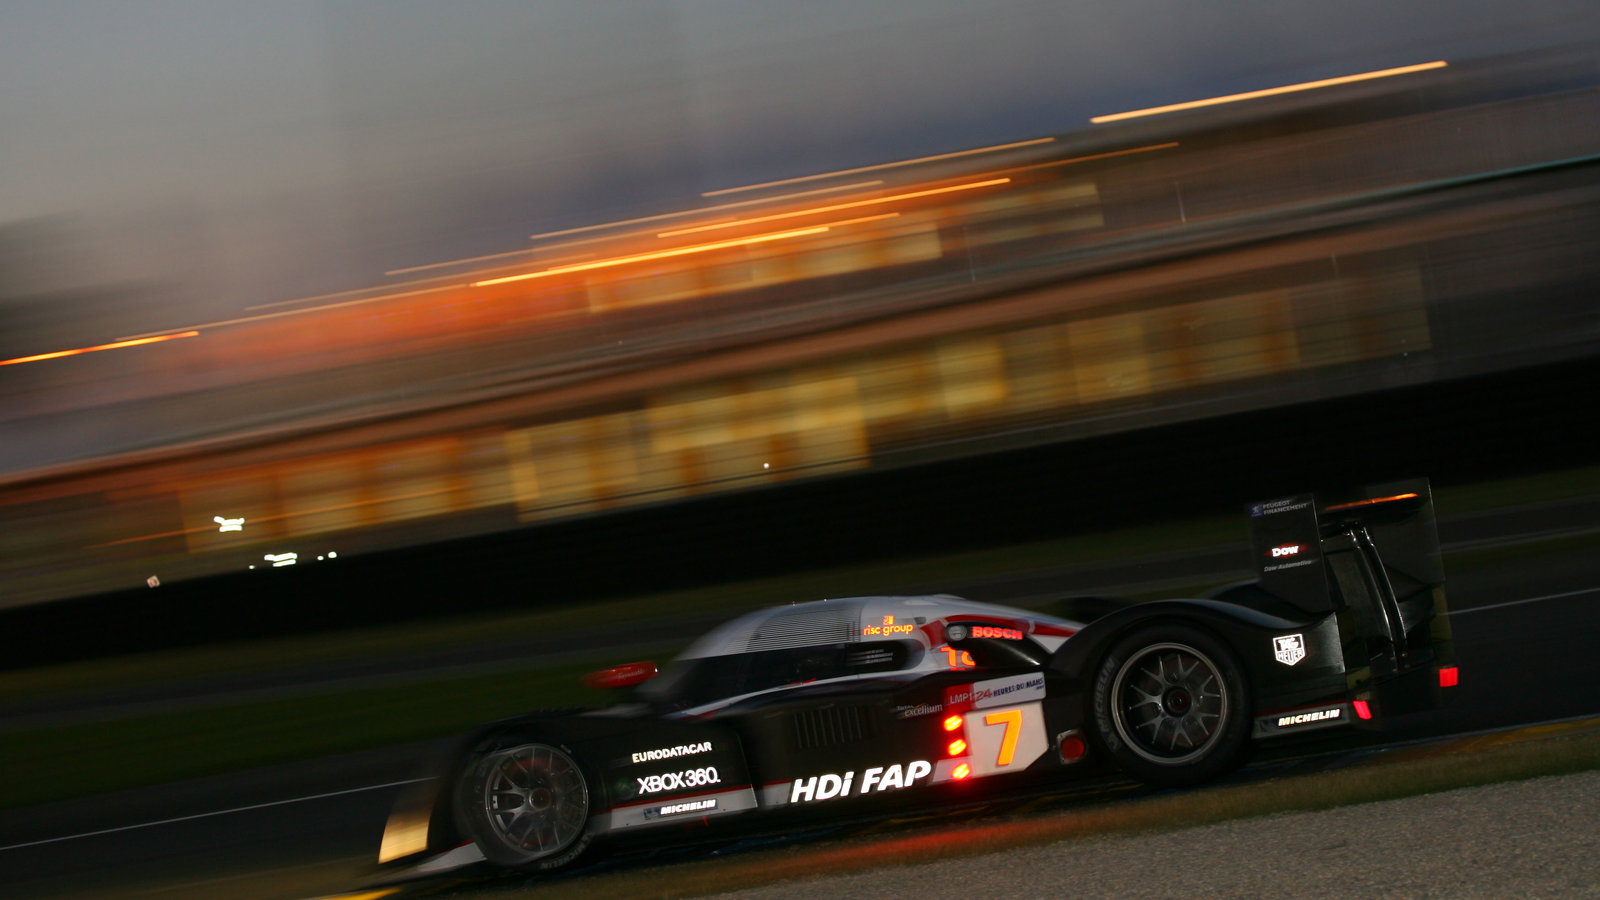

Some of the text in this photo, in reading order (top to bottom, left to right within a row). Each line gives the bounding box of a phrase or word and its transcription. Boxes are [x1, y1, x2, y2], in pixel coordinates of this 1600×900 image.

[863, 624, 914, 636] risc group
[972, 626, 1023, 640] BOSCH
[1278, 709, 1340, 726] MICHELIN
[985, 710, 1022, 766] 7
[632, 741, 712, 763] EURODATACAR
[790, 760, 931, 803] HDi FAP
[660, 800, 716, 815] MICHELIN
